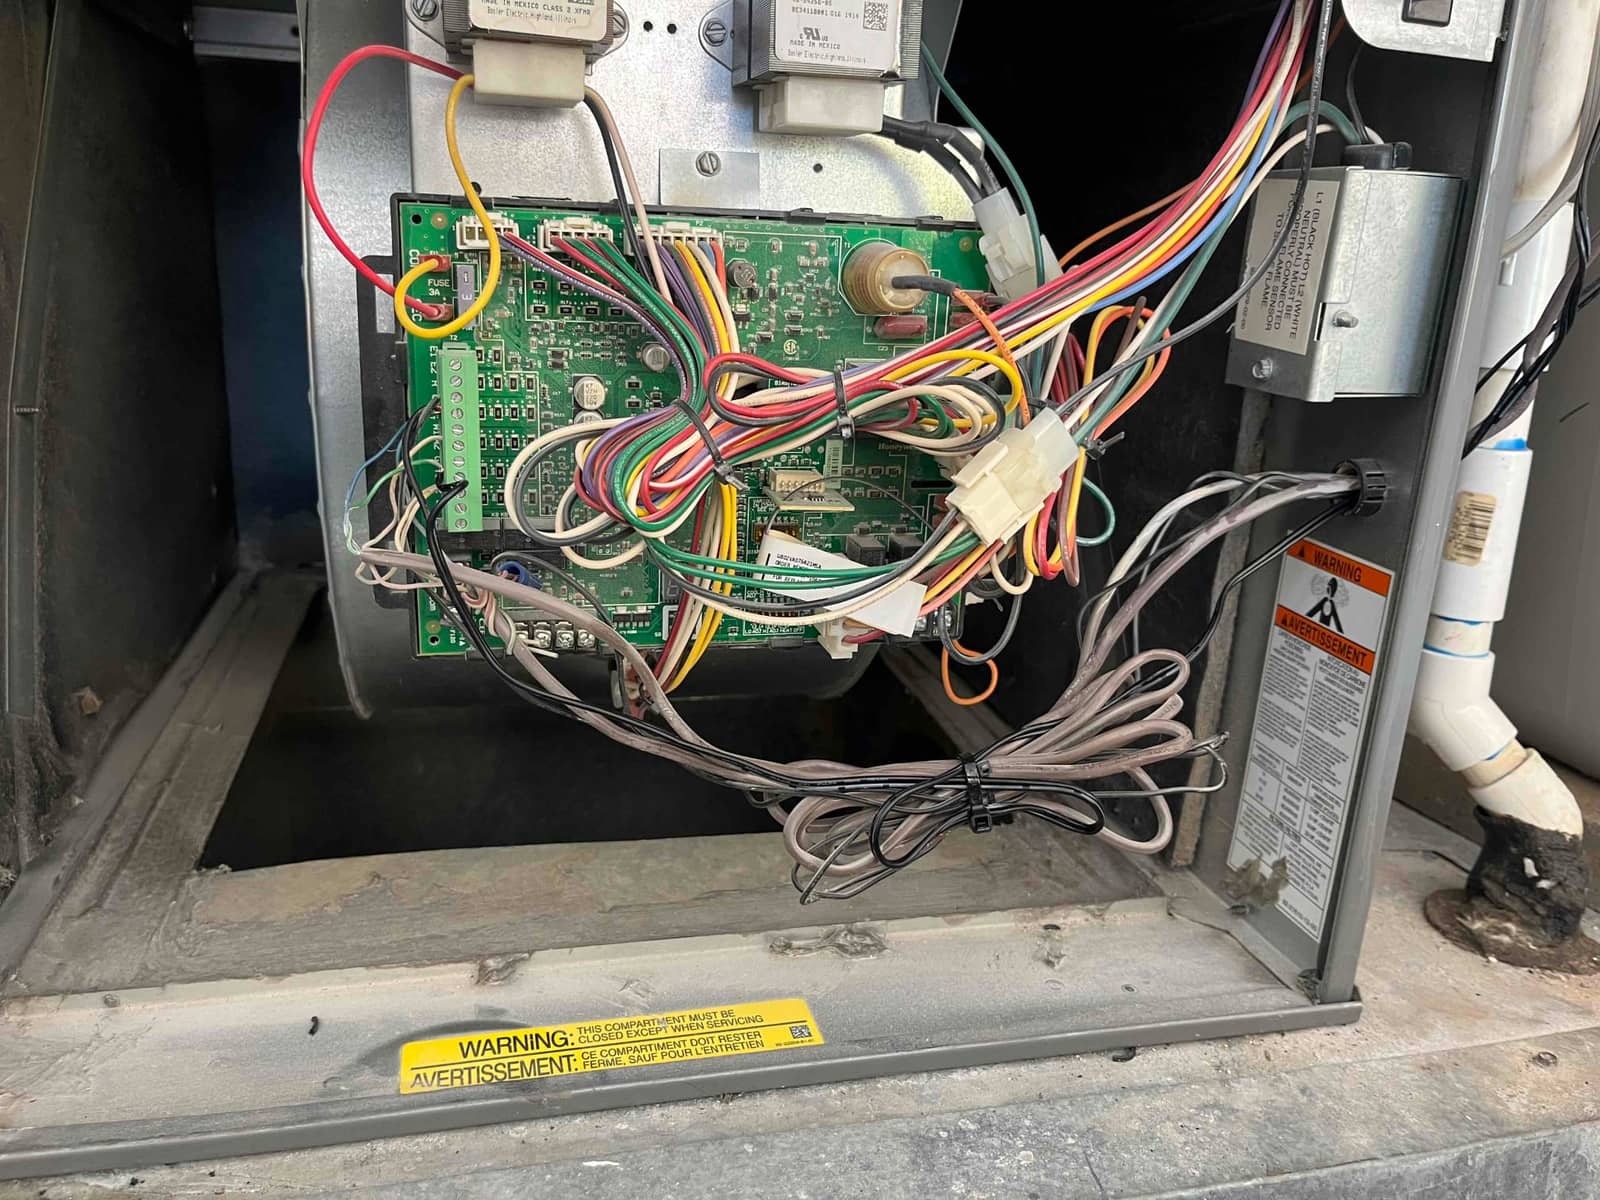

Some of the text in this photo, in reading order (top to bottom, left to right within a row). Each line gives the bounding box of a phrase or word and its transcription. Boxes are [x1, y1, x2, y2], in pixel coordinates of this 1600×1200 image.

[514, 0, 539, 9] MEXICO
[1315, 192, 1324, 204] L1
[1275, 214, 1284, 228] TO
[1306, 208, 1320, 250] (BLACK
[1274, 246, 1287, 282] FLAME
[1284, 210, 1311, 320] NEUTRAL) MUST BE
[1299, 253, 1312, 281] HOT)
[427, 279, 450, 287] FUSE
[428, 288, 440, 296] 3A
[1260, 271, 1273, 308] FLAME
[1274, 260, 1293, 330] CONNECTED
[1264, 285, 1279, 331] SENSOR
[1289, 299, 1302, 339] (WHITE
[1313, 549, 1362, 583] WARNING
[1287, 618, 1367, 667] AVERTISSEMENT
[576, 1025, 602, 1035] THIS
[689, 1011, 718, 1022] MUST
[721, 1009, 736, 1019] BE
[578, 1015, 764, 1044] CLOSED EXCEPT WHEN SERVICING
[458, 1030, 575, 1059] WARNING:
[581, 1031, 762, 1060] CE COMPARTIMENT DOIT RESTER
[583, 1058, 626, 1070] FERME,
[628, 1054, 658, 1064] SAUF
[661, 1048, 693, 1060] POUR
[695, 1040, 765, 1056] L'ENTRETIEN
[410, 1054, 579, 1088] AVERTISSEMENT:
